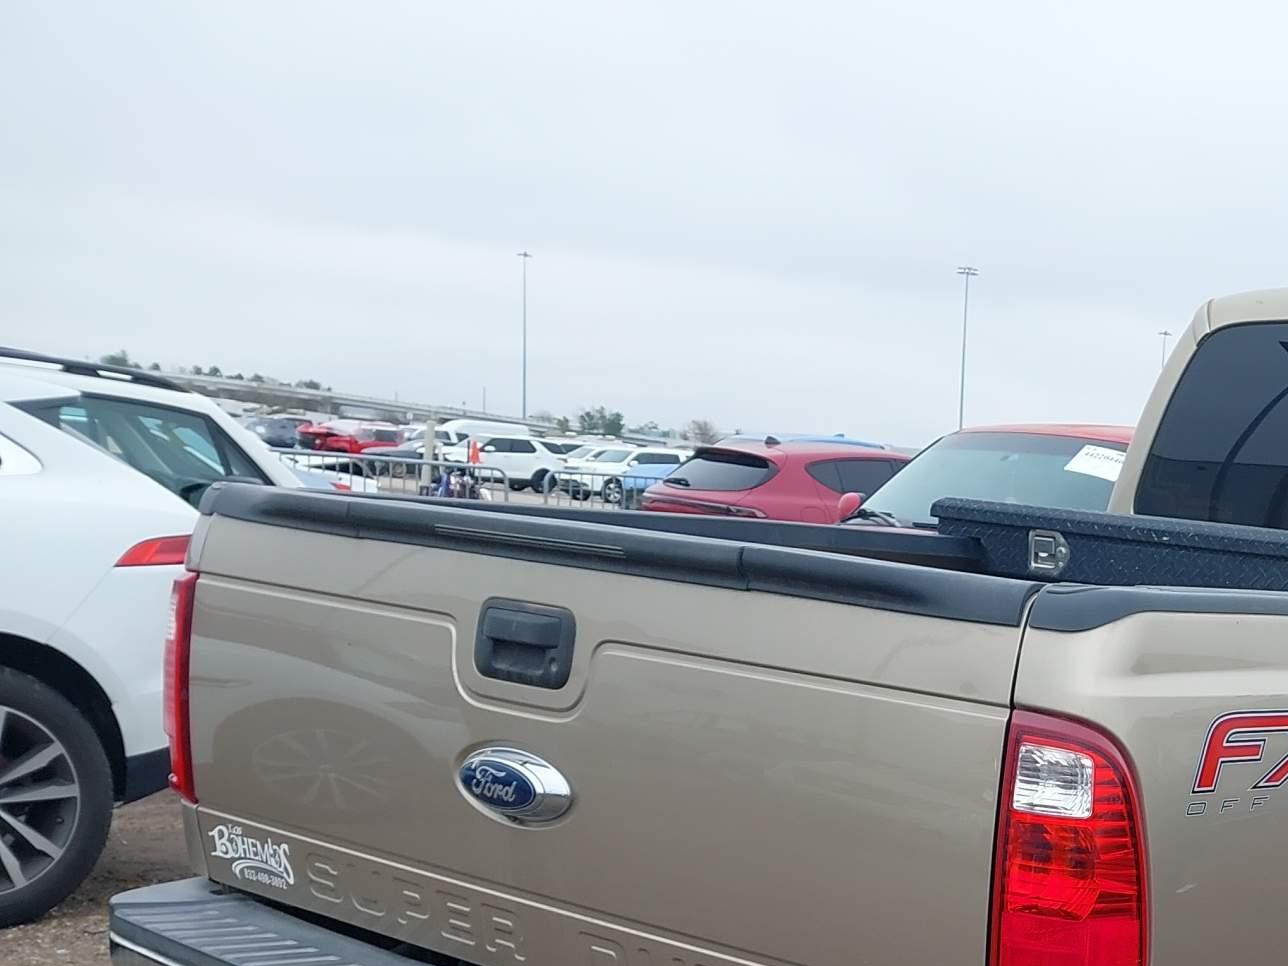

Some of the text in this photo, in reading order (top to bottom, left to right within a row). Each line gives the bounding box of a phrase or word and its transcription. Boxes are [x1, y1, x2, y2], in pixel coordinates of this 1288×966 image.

[471, 765, 518, 802] Ford
[1186, 796, 1269, 816] OFF
[306, 852, 527, 961] SUPER
